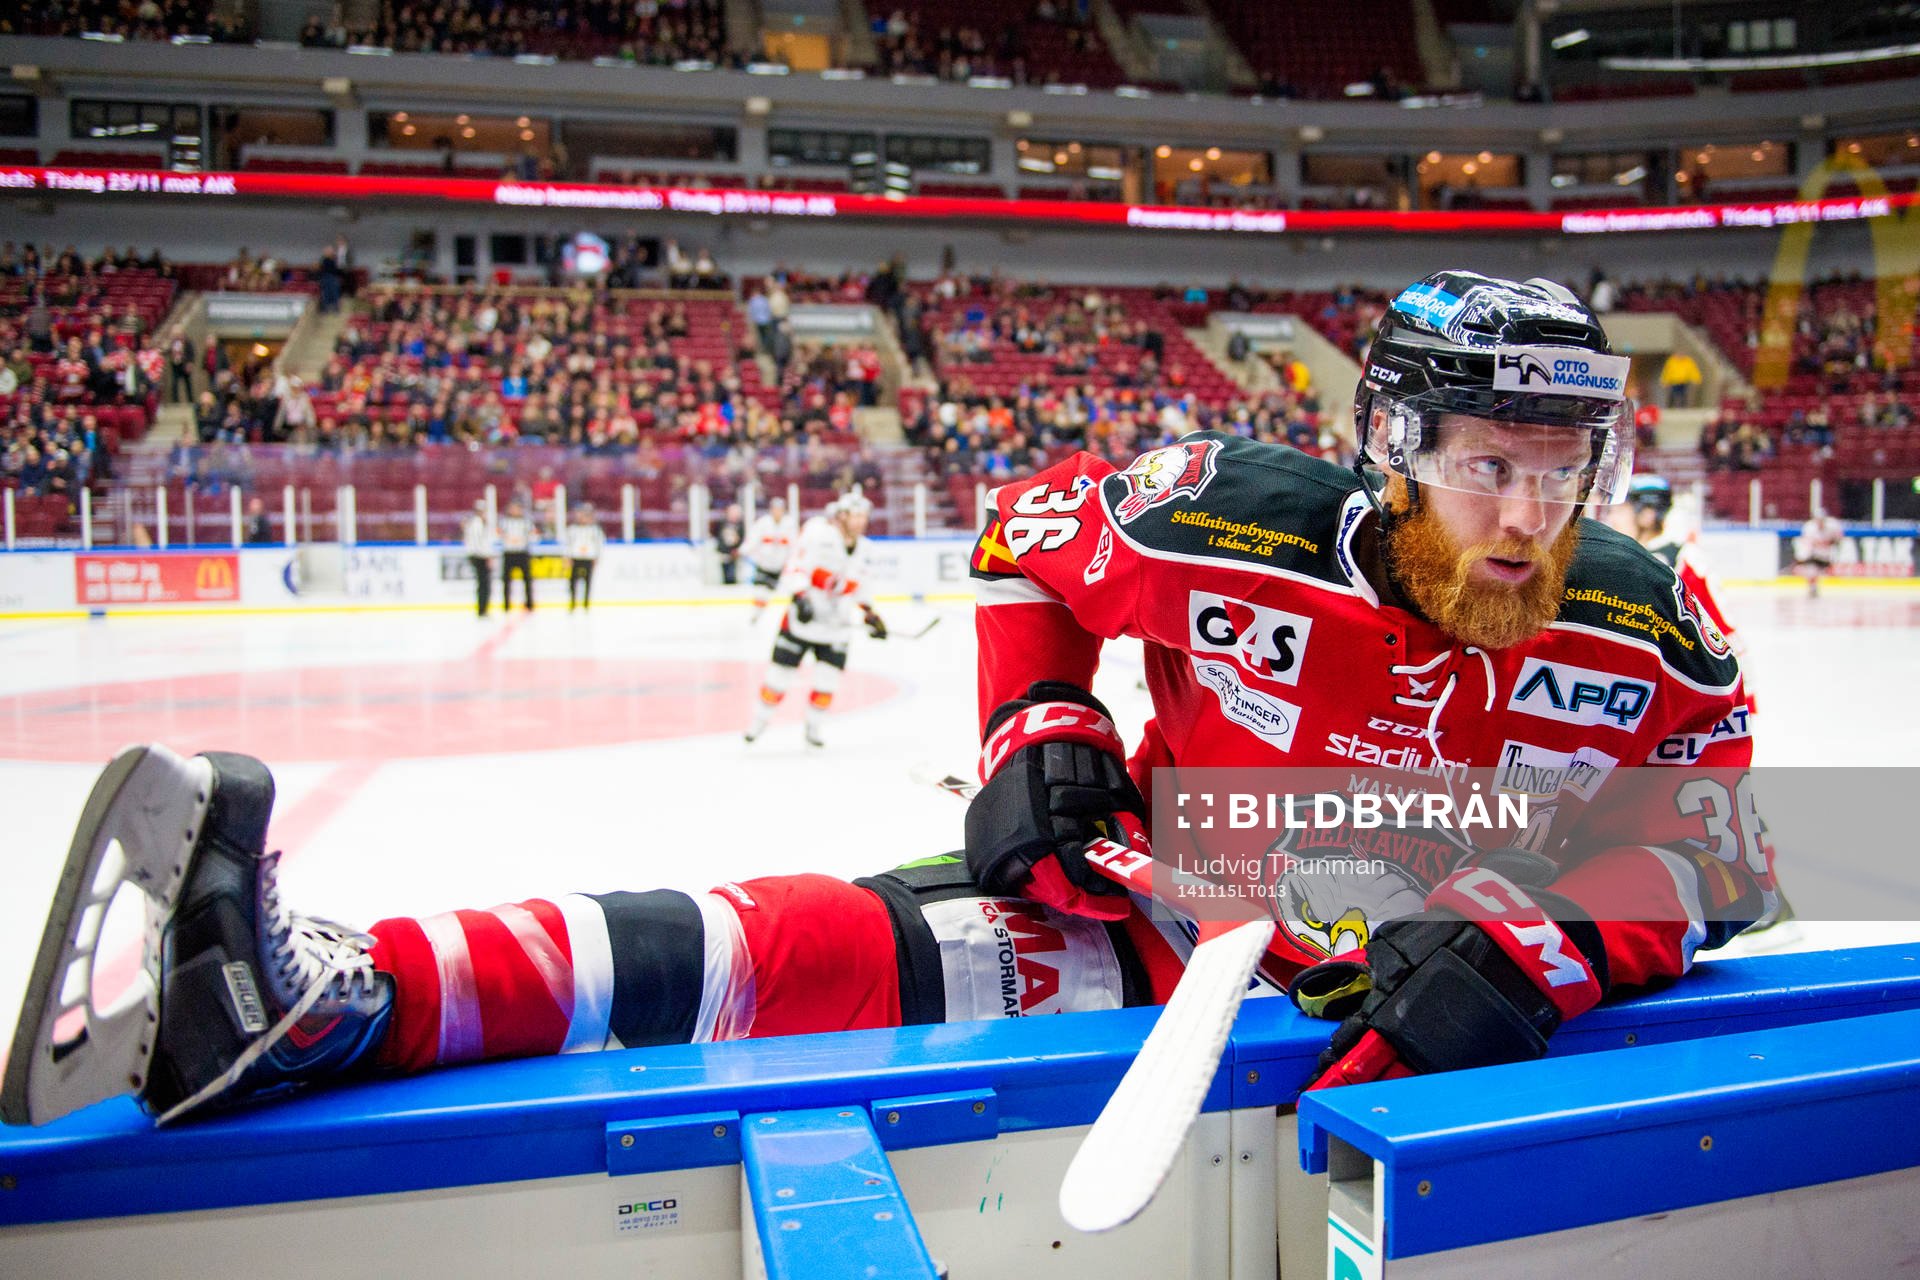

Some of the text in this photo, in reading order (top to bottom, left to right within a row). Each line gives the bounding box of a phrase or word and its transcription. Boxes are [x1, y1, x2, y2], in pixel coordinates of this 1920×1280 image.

[1370, 364, 1402, 385] CCM
[1553, 359, 1590, 374] OTTO
[1004, 474, 1086, 564] 36
[1170, 510, 1319, 554] Ställningsbyggarna
[1207, 534, 1274, 557] i Skåne AB
[1564, 588, 1695, 651] Ställningsbyggarna
[1606, 612, 1613, 622] i
[1196, 600, 1297, 678] G4S
[1324, 732, 1470, 785] stadium
[618, 1198, 677, 1215] DACO
